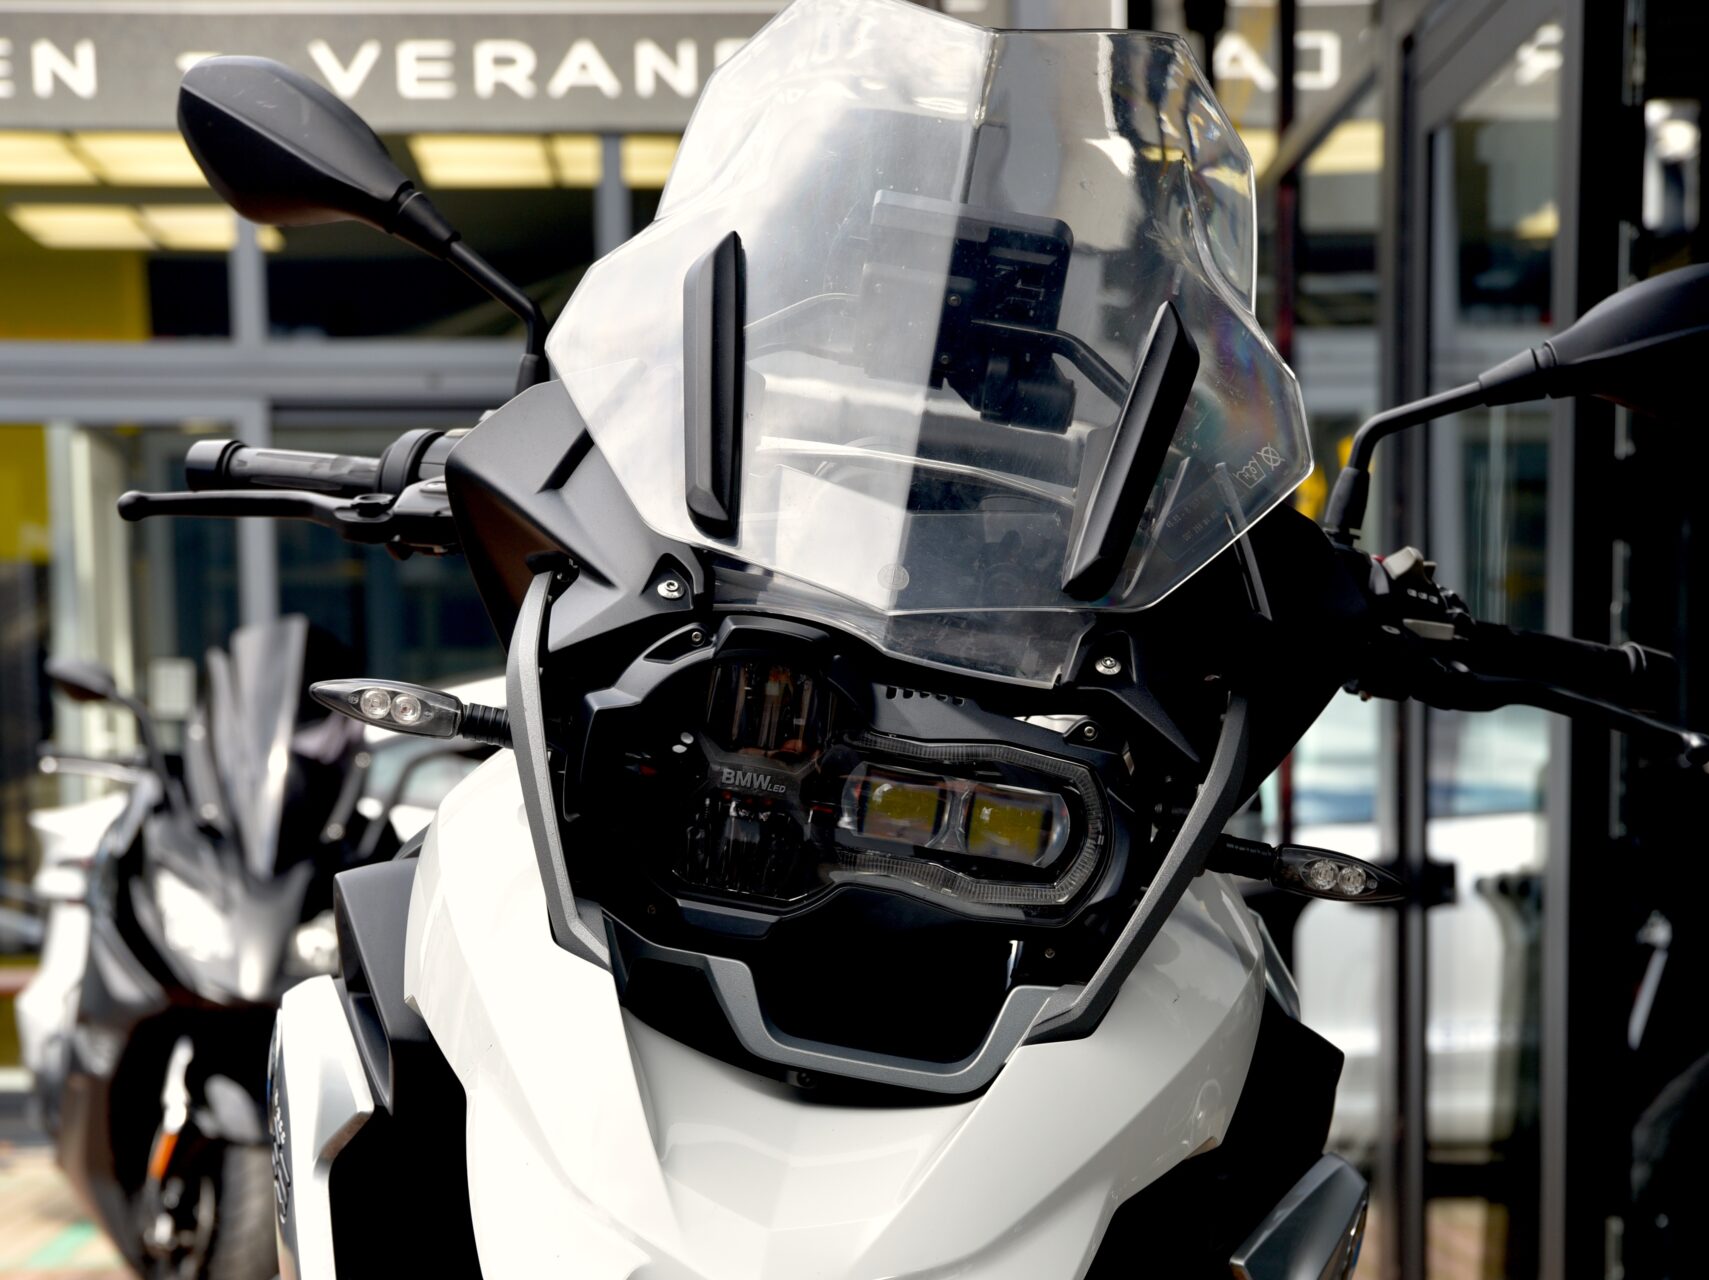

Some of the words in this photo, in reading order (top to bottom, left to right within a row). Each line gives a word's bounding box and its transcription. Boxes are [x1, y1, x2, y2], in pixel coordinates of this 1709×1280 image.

[0, 37, 97, 99] N
[721, 767, 771, 790] BMW
[767, 784, 786, 793] LED
